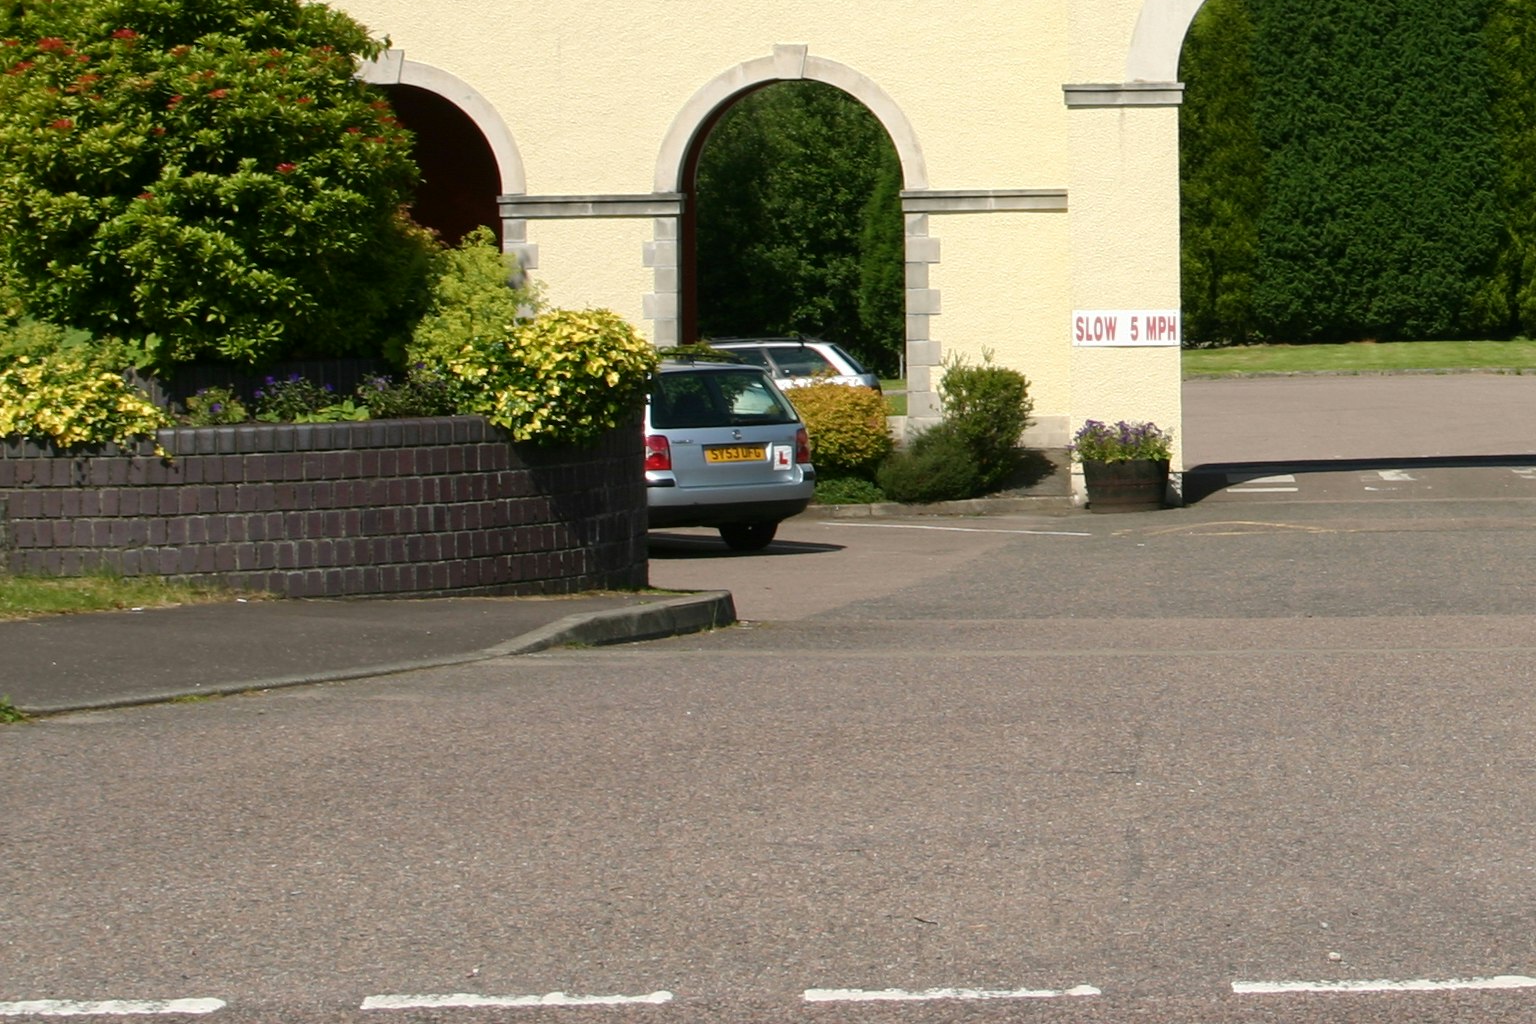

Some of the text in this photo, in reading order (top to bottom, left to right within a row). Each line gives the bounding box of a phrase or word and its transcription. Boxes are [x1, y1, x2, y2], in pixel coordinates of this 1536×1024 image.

[1075, 316, 1177, 342] SLOW 5 MPH
[710, 447, 740, 461] SY53
[779, 450, 788, 465] L
